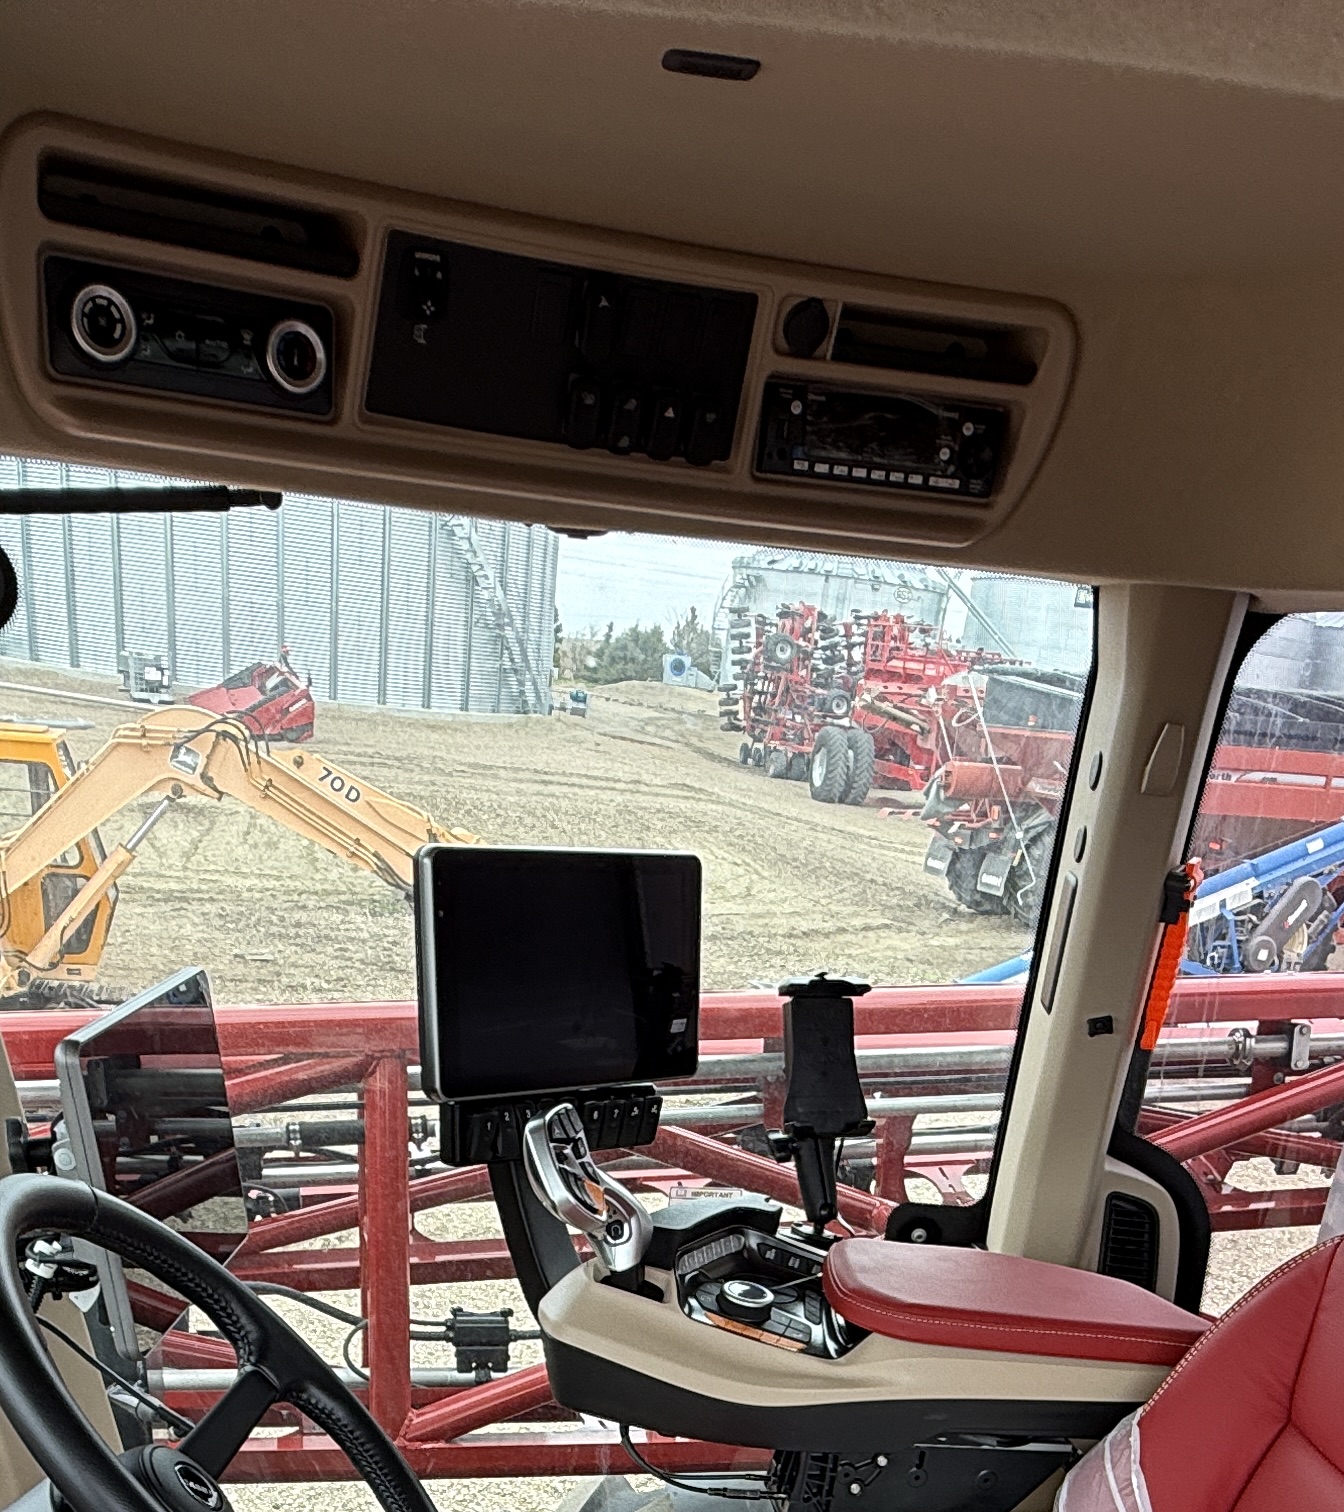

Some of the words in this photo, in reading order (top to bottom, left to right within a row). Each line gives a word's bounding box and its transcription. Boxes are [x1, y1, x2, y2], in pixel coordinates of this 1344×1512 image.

[318, 766, 361, 803] 70D
[504, 1111, 510, 1121] 2
[526, 1109, 531, 1119] 3
[691, 1191, 734, 1199] IMPORTANT
